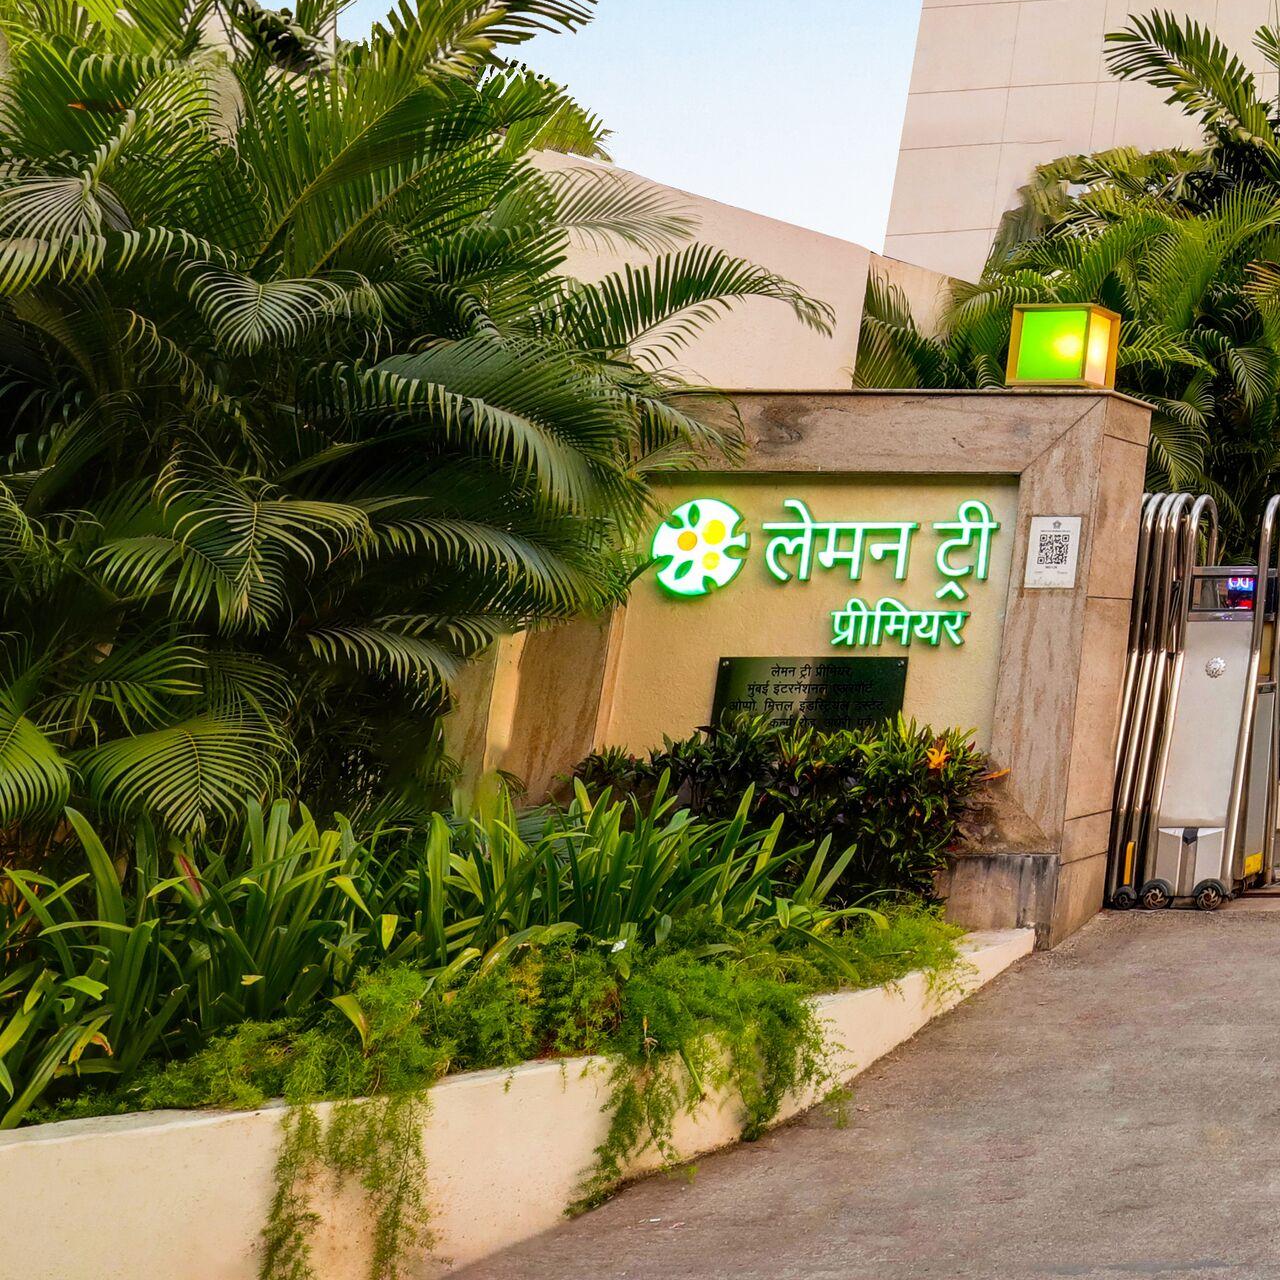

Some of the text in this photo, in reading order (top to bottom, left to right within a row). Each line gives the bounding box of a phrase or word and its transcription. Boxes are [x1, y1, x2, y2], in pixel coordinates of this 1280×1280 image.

[762, 498, 1001, 601] लेमन ट्री
[830, 596, 971, 647] प्रीमियर
[770, 662, 797, 677] लेमन
[800, 663, 812, 679] ट्री
[747, 680, 770, 697] मुंबई
[764, 697, 794, 711] मित्तल
